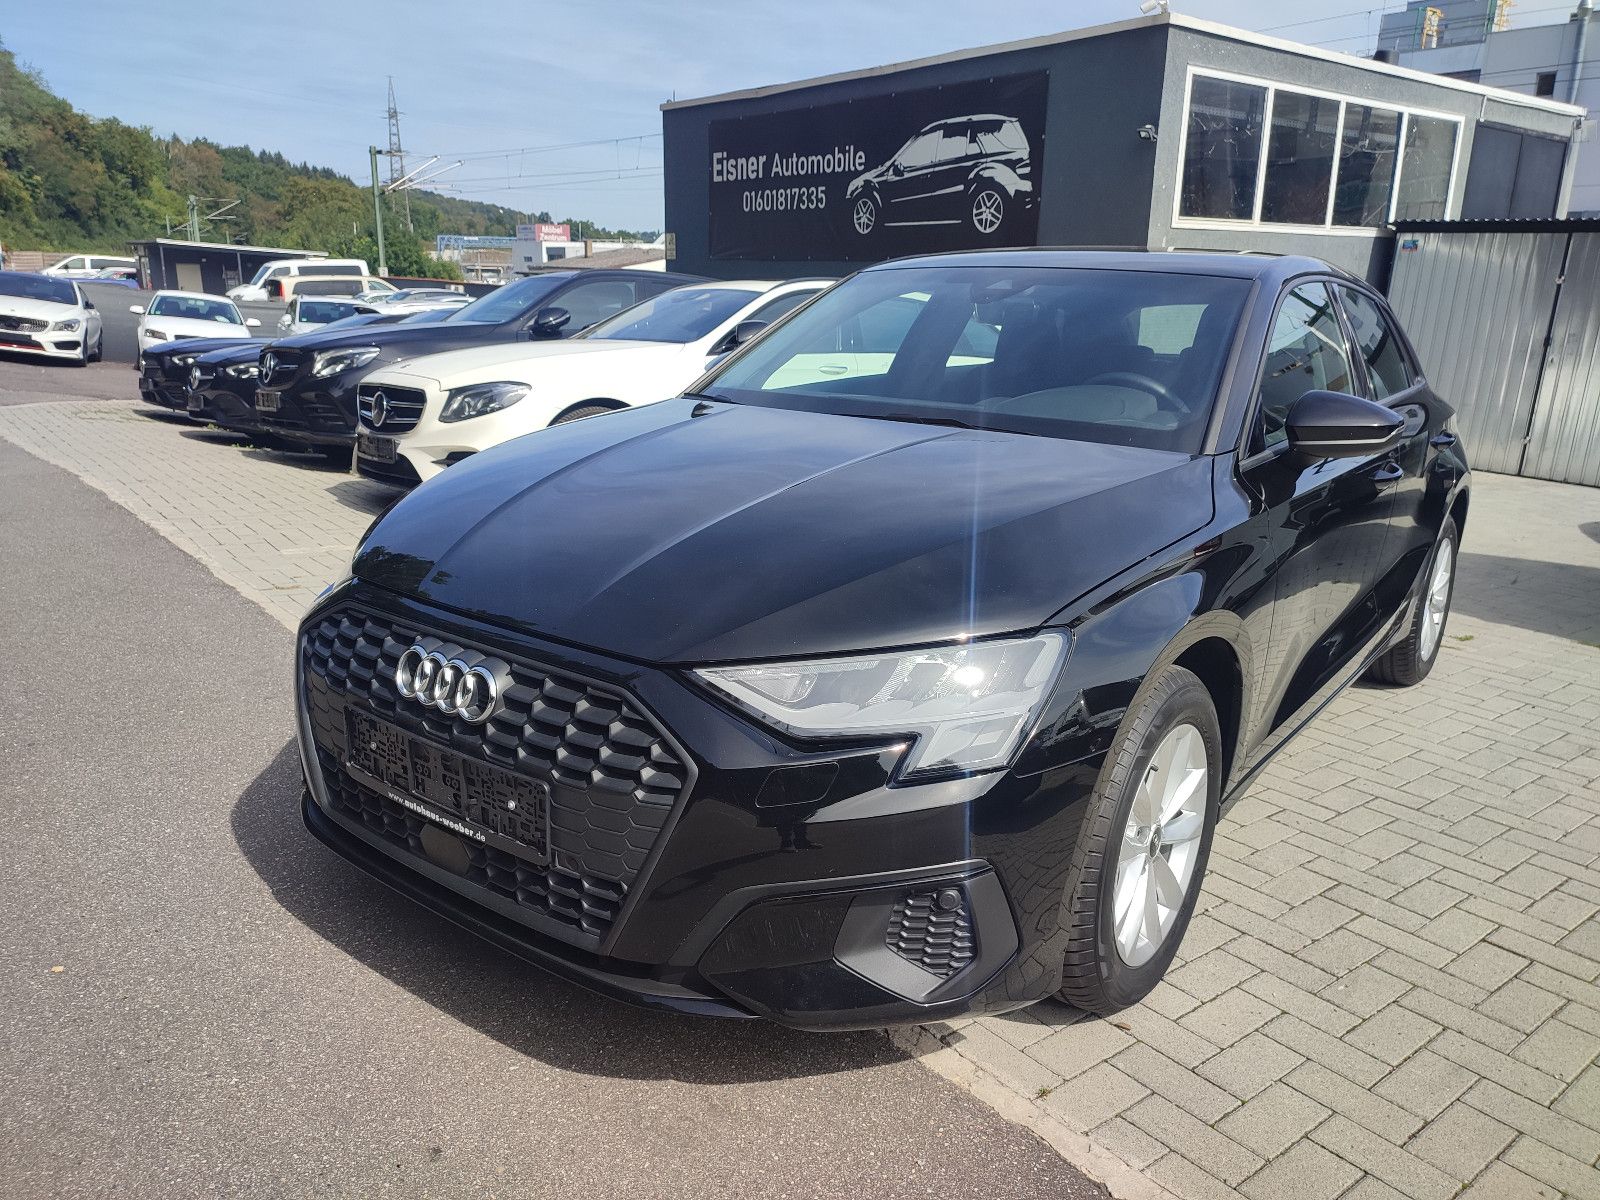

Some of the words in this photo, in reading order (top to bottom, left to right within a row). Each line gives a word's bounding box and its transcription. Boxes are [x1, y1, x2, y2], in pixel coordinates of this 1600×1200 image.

[712, 151, 767, 183] Eisner
[771, 145, 866, 178] Automobile
[743, 186, 826, 212] 01601817335
